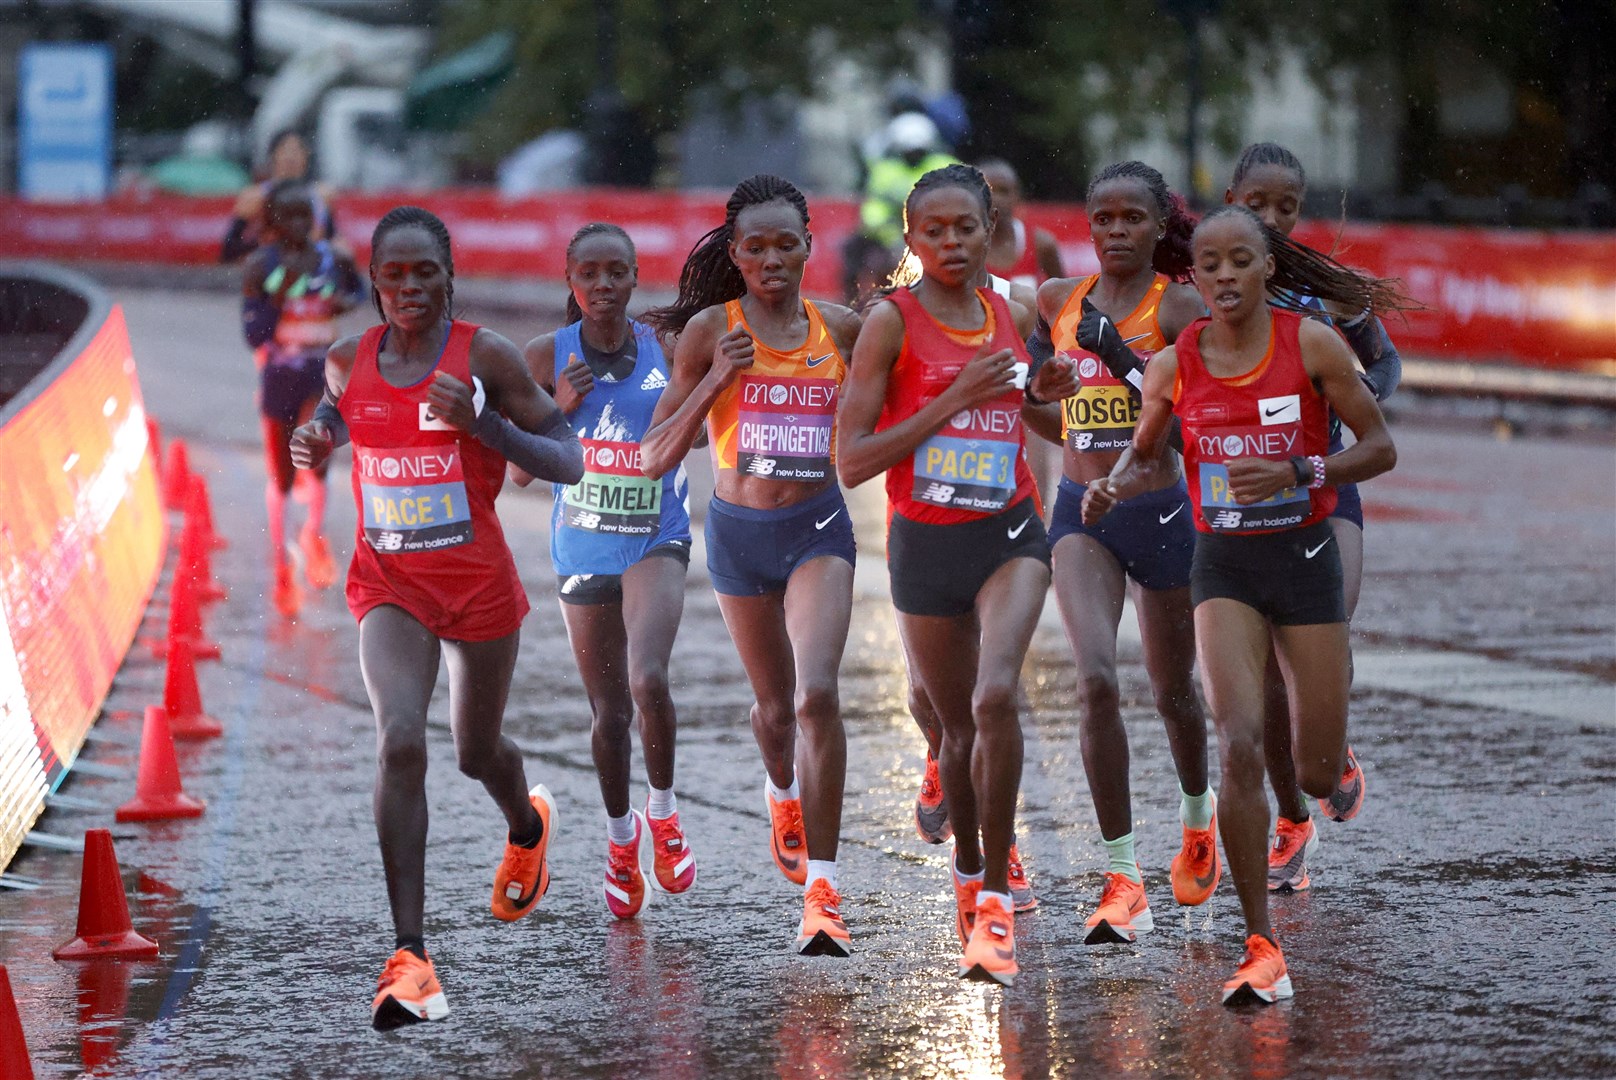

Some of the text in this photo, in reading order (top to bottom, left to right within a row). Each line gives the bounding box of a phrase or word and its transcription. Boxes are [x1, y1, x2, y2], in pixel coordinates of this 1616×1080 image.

[641, 380, 667, 390] adida
[744, 383, 834, 406] MONEY
[950, 408, 1018, 433] ONEY
[1065, 397, 1142, 425] KOSGE
[741, 422, 830, 455] CHEPNGETICH
[1094, 440, 1112, 449] new
[1113, 438, 1133, 448] bala
[1199, 430, 1298, 457] MONEY
[362, 453, 454, 478] MONEY
[581, 445, 641, 469] ONE
[926, 447, 1009, 483] PACE 3
[776, 469, 793, 477] new
[795, 468, 824, 478] balance
[572, 482, 656, 511] JEMELI
[953, 496, 973, 506] new
[973, 497, 1004, 509] balanc
[373, 493, 454, 526] PACE 1
[1244, 519, 1263, 528] new
[1264, 515, 1302, 527] balance
[600, 523, 617, 533] new
[618, 522, 652, 534] balance
[404, 541, 424, 550] new
[424, 534, 463, 549] balance
